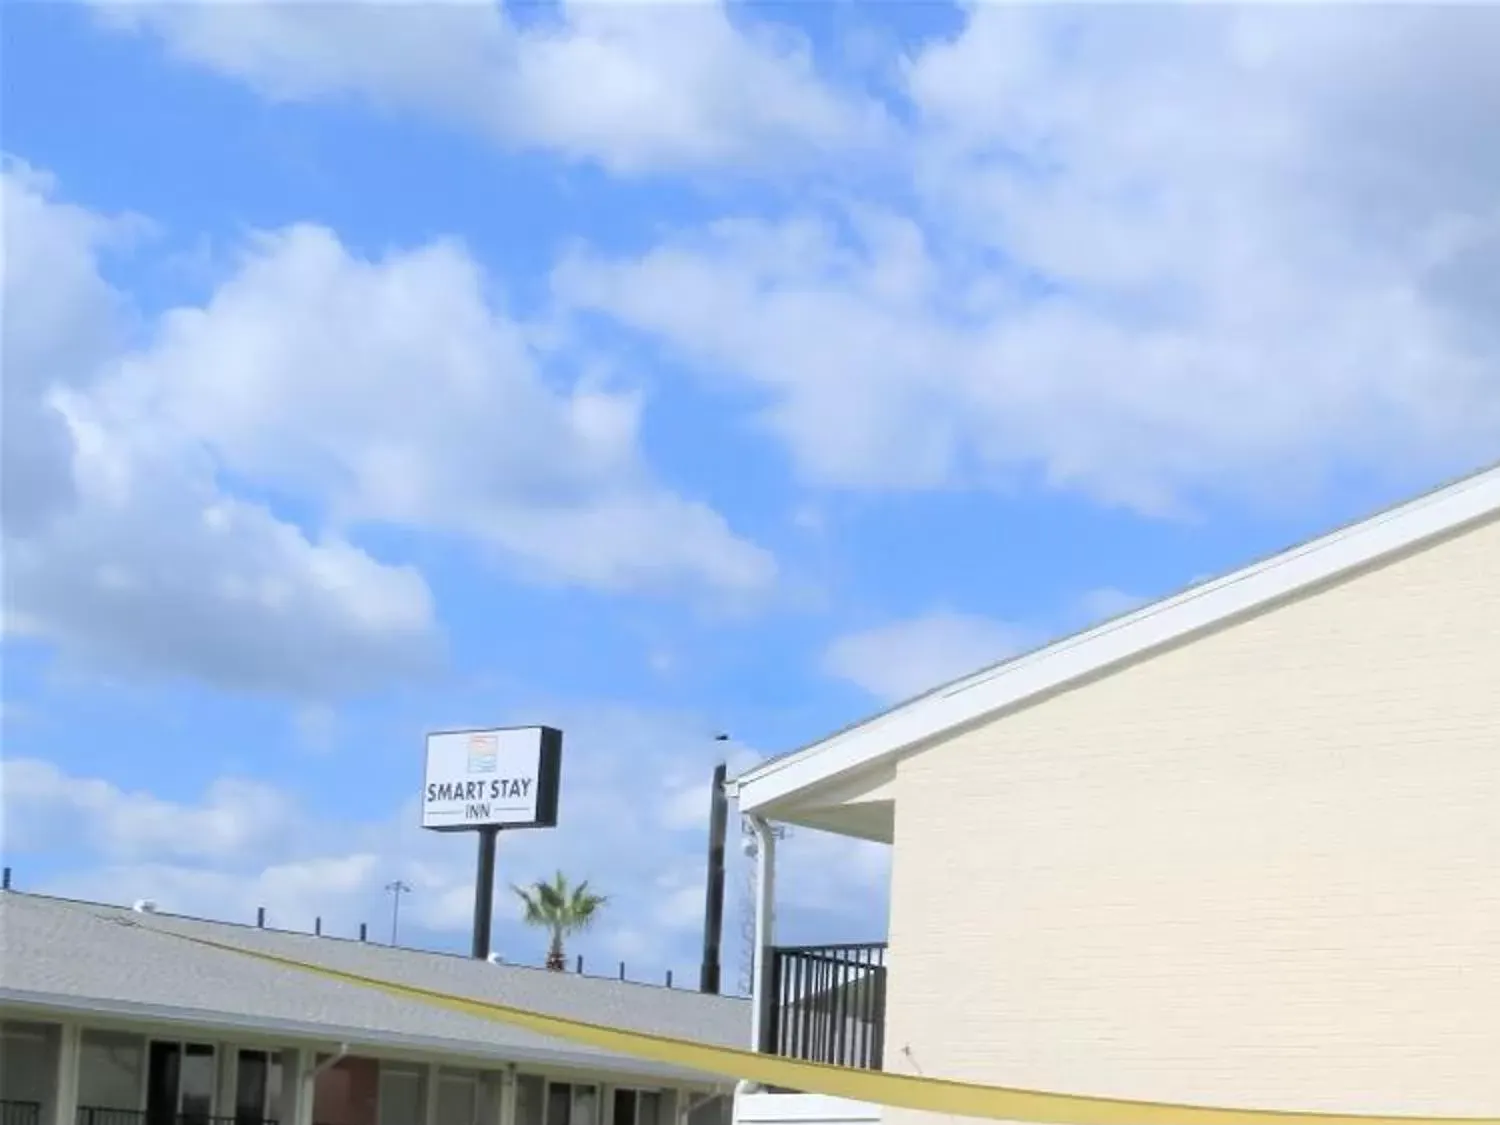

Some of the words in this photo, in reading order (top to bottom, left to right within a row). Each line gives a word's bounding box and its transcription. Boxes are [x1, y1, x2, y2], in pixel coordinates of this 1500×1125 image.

[428, 781, 486, 802] SMART
[490, 778, 532, 799] STAY
[466, 803, 490, 819] INN
